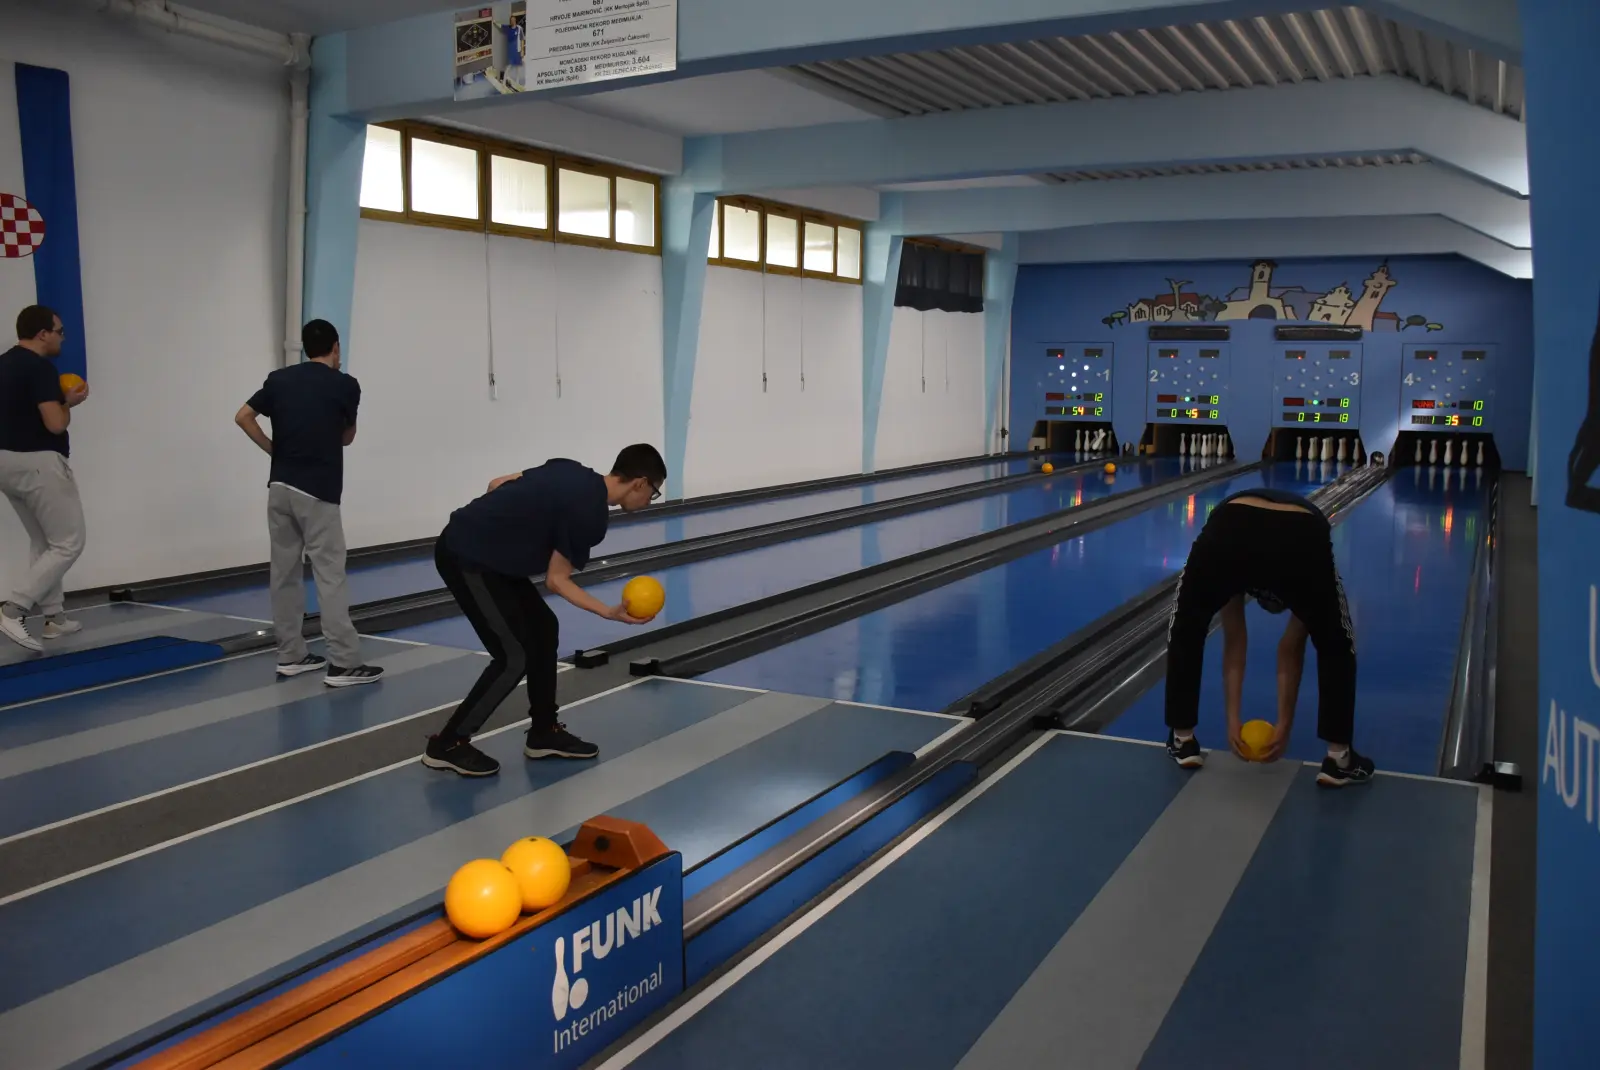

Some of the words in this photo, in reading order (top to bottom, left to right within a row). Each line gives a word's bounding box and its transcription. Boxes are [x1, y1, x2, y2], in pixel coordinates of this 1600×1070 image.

[550, 13, 571, 22] HRVOJE
[589, 20, 610, 28] REKORD
[593, 29, 604, 37] 671
[549, 45, 574, 53] PREDRAG
[632, 56, 650, 64] 3.604
[569, 64, 587, 74] 3.683
[1103, 369, 1110, 381] 1
[1150, 370, 1158, 382] 2
[1350, 372, 1359, 385] 3
[1403, 372, 1414, 386] 4
[1094, 392, 1103, 402] 12
[1209, 395, 1219, 404] 18
[1340, 398, 1349, 408] 18
[1473, 400, 1484, 410] 10
[1094, 407, 1103, 416] 12
[1171, 408, 1177, 418] 0
[1209, 409, 1218, 419] 18
[1298, 412, 1304, 422] 0
[1314, 412, 1320, 422] 3
[1339, 413, 1349, 423] 18
[1472, 416, 1482, 426] 10
[1543, 698, 1600, 833] AUT
[573, 885, 662, 974] FUNK
[554, 962, 662, 1054] International
